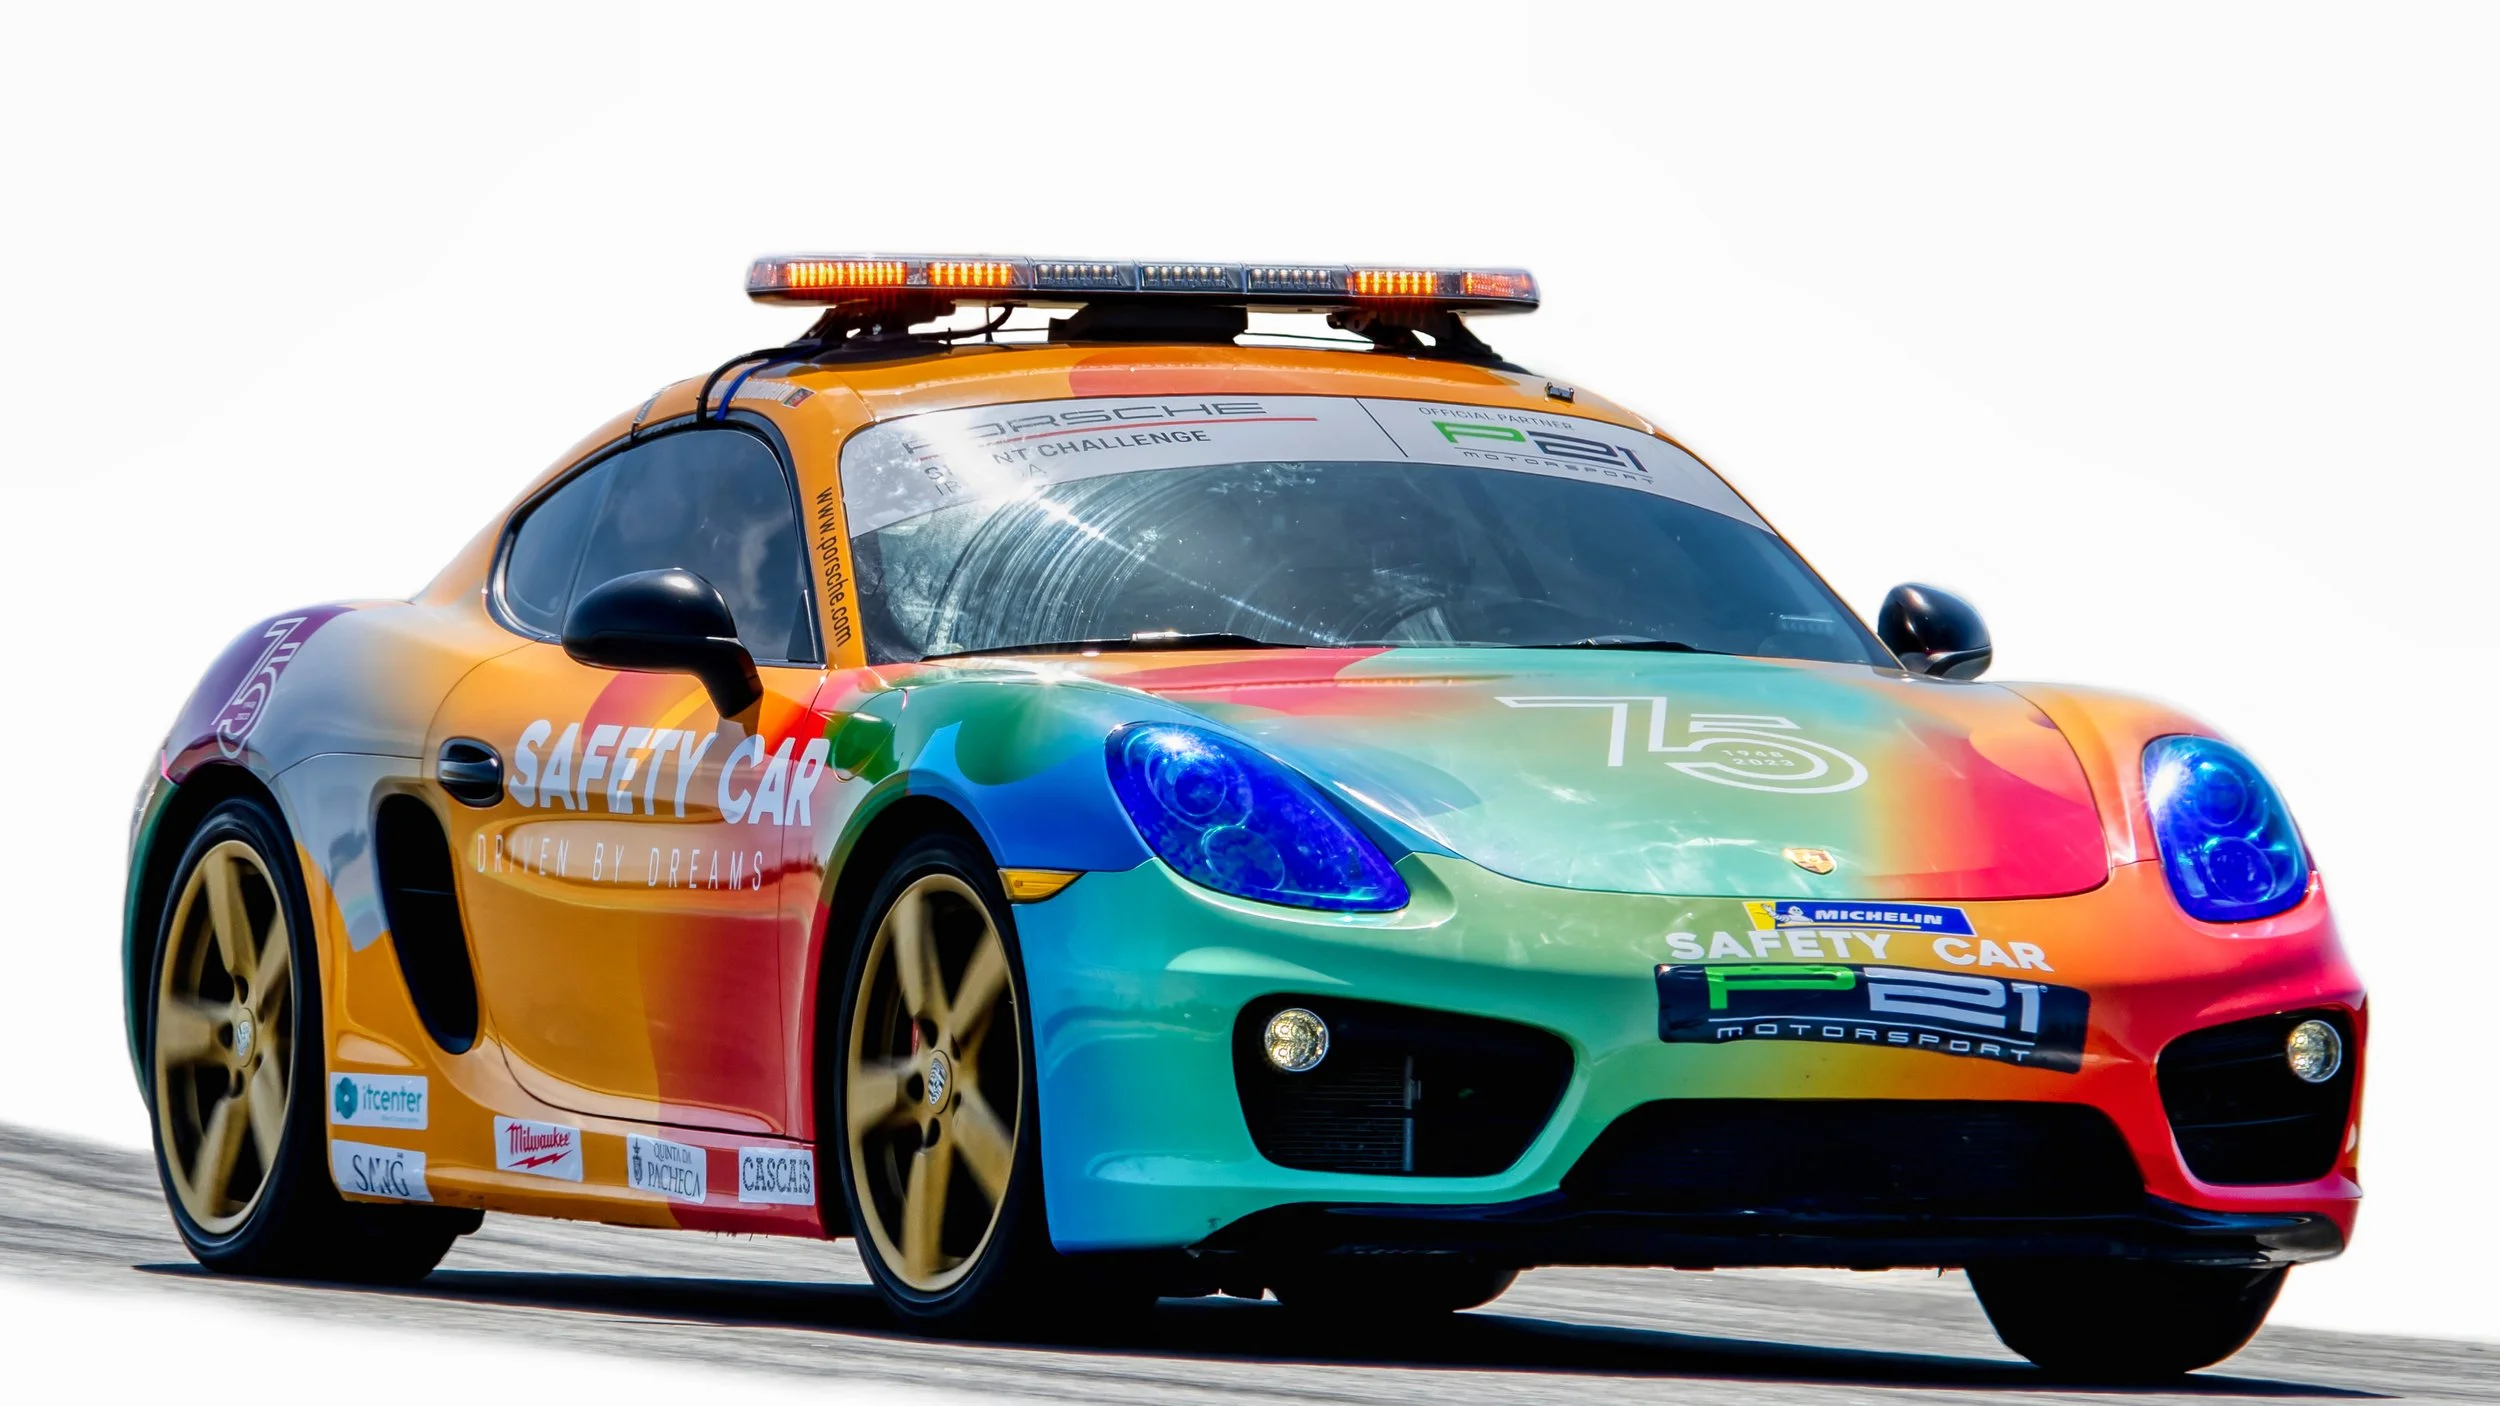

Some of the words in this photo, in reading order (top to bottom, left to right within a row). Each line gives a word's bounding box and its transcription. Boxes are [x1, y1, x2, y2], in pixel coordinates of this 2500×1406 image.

[1418, 406, 1496, 421] OFFICIAL
[1497, 413, 1575, 431] PARTNER
[1037, 429, 1212, 458] CHALLENGE
[1431, 420, 1648, 473] P21
[1463, 450, 1655, 485] MOTORSPORT
[816, 486, 852, 648] www.porsche.com
[1493, 695, 1869, 794] 75
[1732, 758, 1796, 767] 2023
[508, 719, 719, 819] SAFETY
[717, 733, 831, 827] CAR
[477, 834, 570, 877] DRIVEN
[591, 842, 625, 884] BY
[647, 847, 764, 891] DREAMS
[1814, 909, 1944, 926] MICHELIN
[1665, 930, 1891, 960] SAFETY
[1932, 936, 2055, 973] CAR
[1704, 964, 2041, 1034] P21
[1716, 1023, 2031, 1063] MOTORSPORT
[361, 1083, 423, 1113] itcenter
[505, 1121, 570, 1156] Milwaukee
[653, 1141, 682, 1161] QUINTA
[682, 1148, 693, 1165] DA
[647, 1161, 701, 1197] PACHECA
[742, 1156, 811, 1195] CASCAIS
